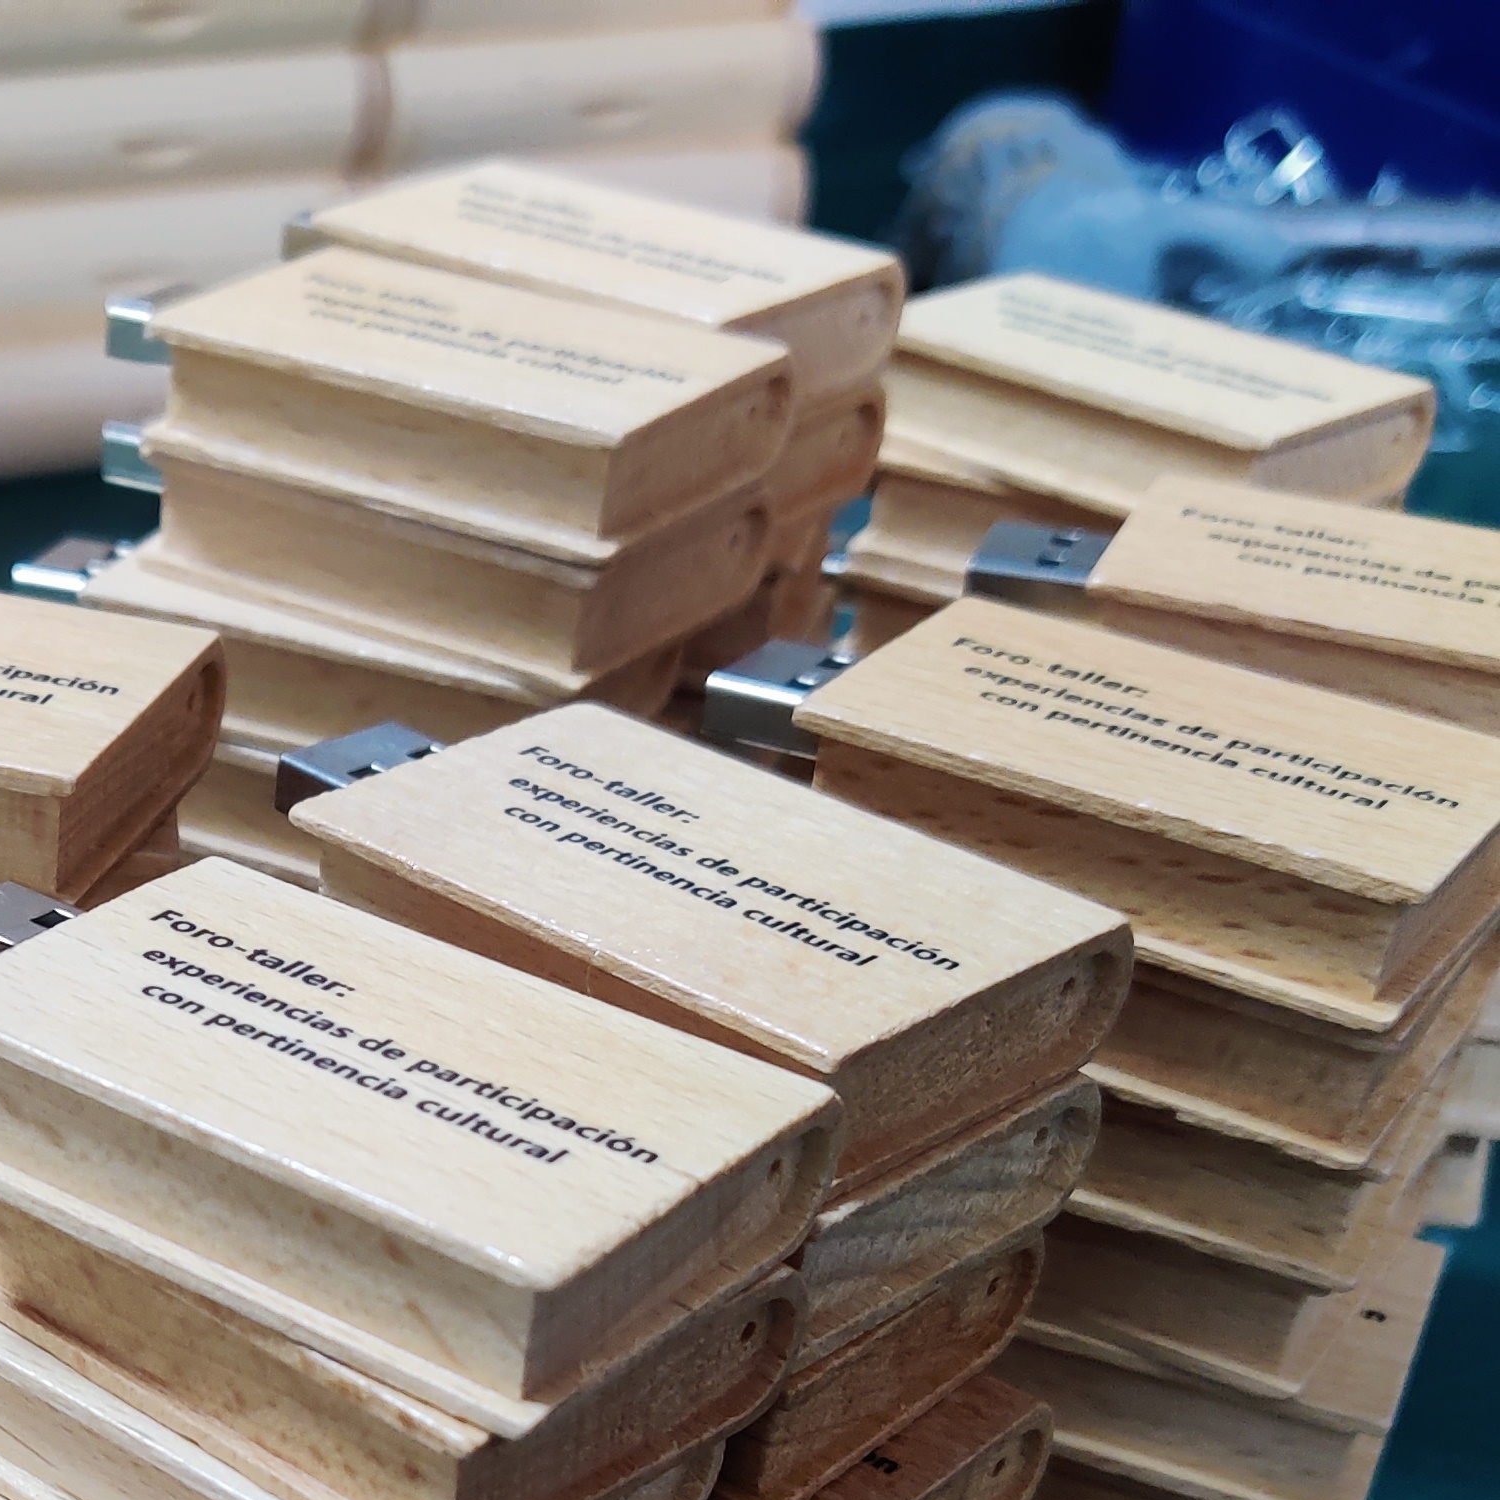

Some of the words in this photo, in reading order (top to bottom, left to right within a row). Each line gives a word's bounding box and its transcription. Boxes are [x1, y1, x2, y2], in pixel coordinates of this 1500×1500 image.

[518, 745, 701, 824] Foro-taller:
[963, 666, 1170, 727] experiencias
[1175, 724, 1220, 742] de
[1226, 738, 1460, 810] participación
[979, 690, 1040, 713] con
[1043, 709, 1240, 769] pertinencia
[1248, 766, 1390, 811] cultural
[503, 806, 562, 833] con
[555, 831, 739, 910] pertinencia
[741, 908, 880, 967] cultural
[507, 777, 695, 858] experiencias
[695, 856, 741, 878] de
[735, 875, 961, 972] participación
[148, 908, 357, 998] Foro-taller:
[140, 984, 207, 1016] con
[201, 1012, 409, 1101] pertinencia
[414, 1099, 571, 1164] cultural
[141, 949, 355, 1038] experiencias
[357, 1037, 407, 1061] de
[403, 1058, 660, 1165] participación
